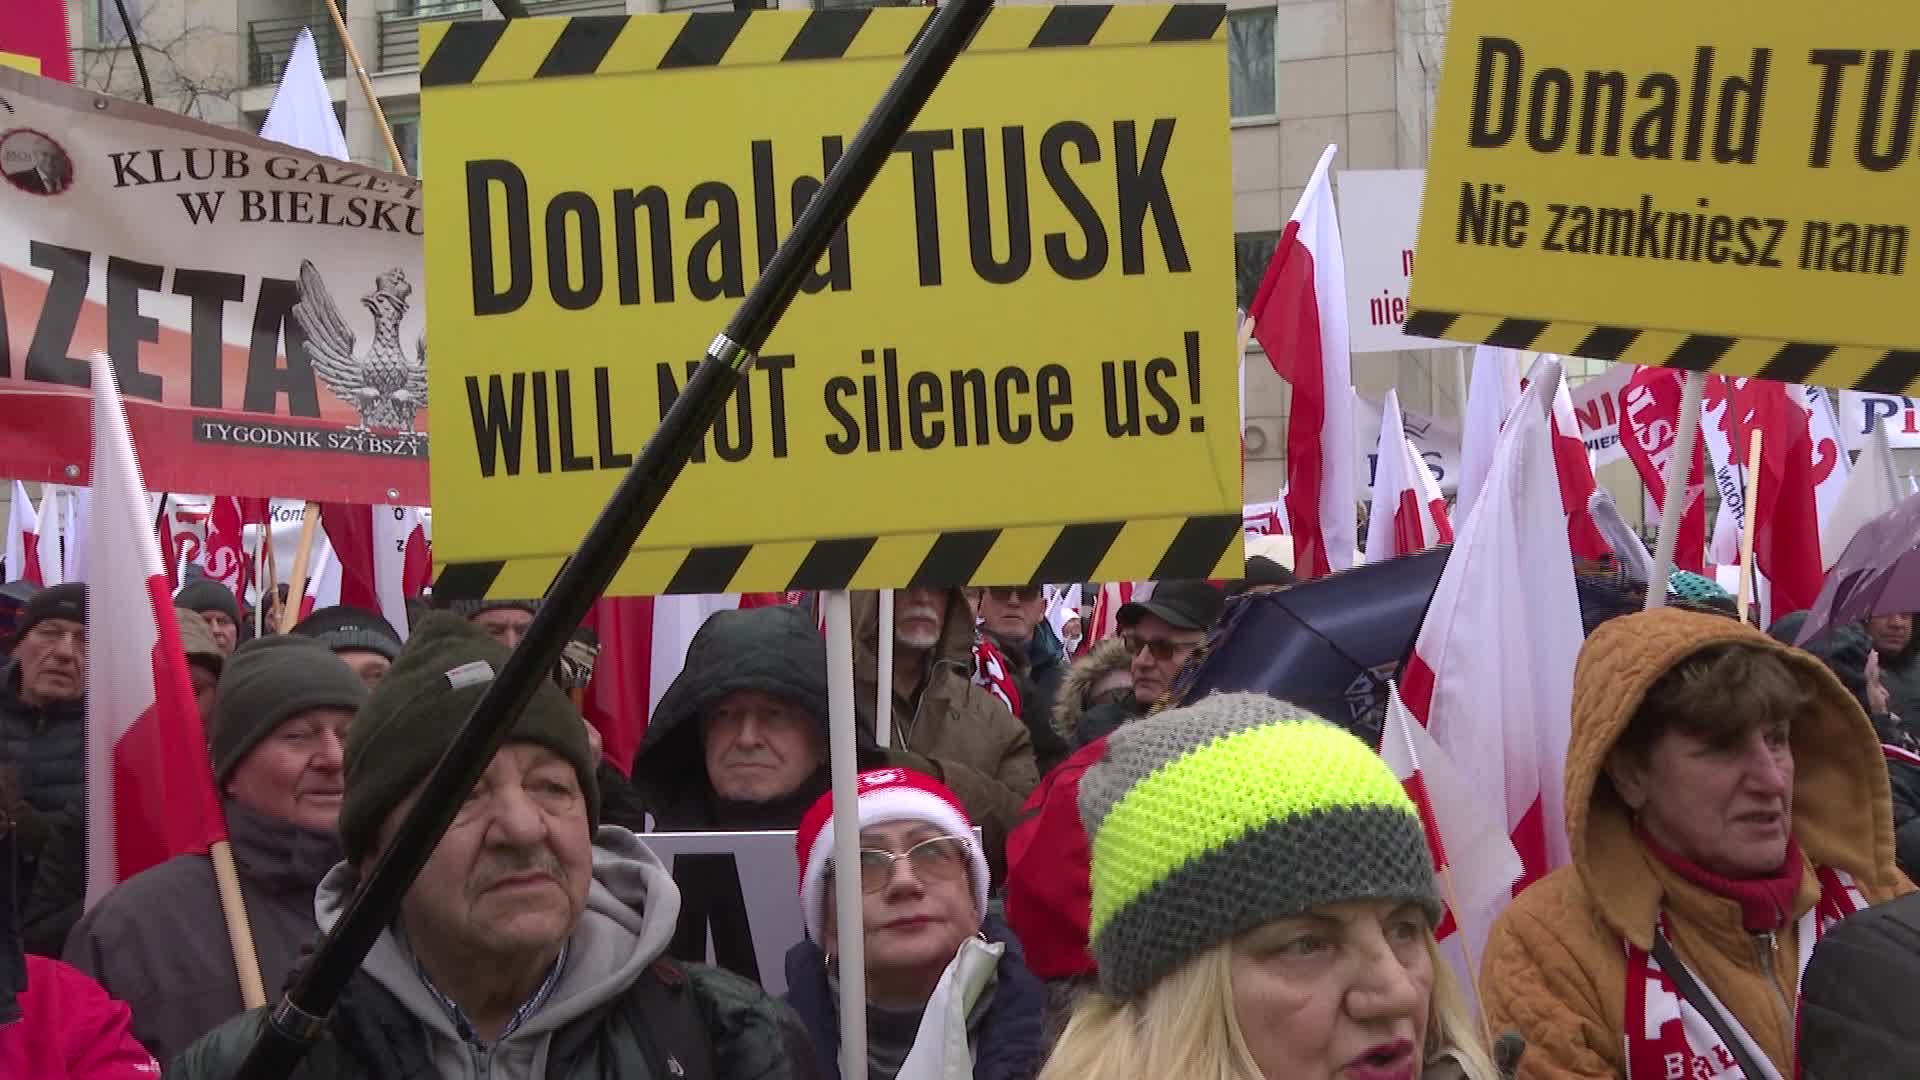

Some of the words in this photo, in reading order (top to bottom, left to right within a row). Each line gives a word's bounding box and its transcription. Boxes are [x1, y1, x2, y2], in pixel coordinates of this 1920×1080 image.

[1468, 35, 1774, 165] Donald
[1807, 48, 1920, 173] TU
[108, 147, 250, 188] KLUB
[177, 192, 226, 225] W
[240, 189, 425, 236] BIELSKU
[465, 135, 852, 316] Donald
[893, 118, 1192, 288] TUSK
[1455, 181, 1530, 248] Nie
[1541, 193, 1788, 268] zamkniesz
[1798, 219, 1910, 276] nam
[1369, 289, 1408, 325] nie
[203, 423, 320, 447] TYGODNIK
[327, 433, 420, 456] SZYBSZY
[465, 366, 633, 478] WILL
[656, 354, 796, 464] NOT
[824, 348, 1074, 455] silence
[1101, 331, 1204, 439] us!
